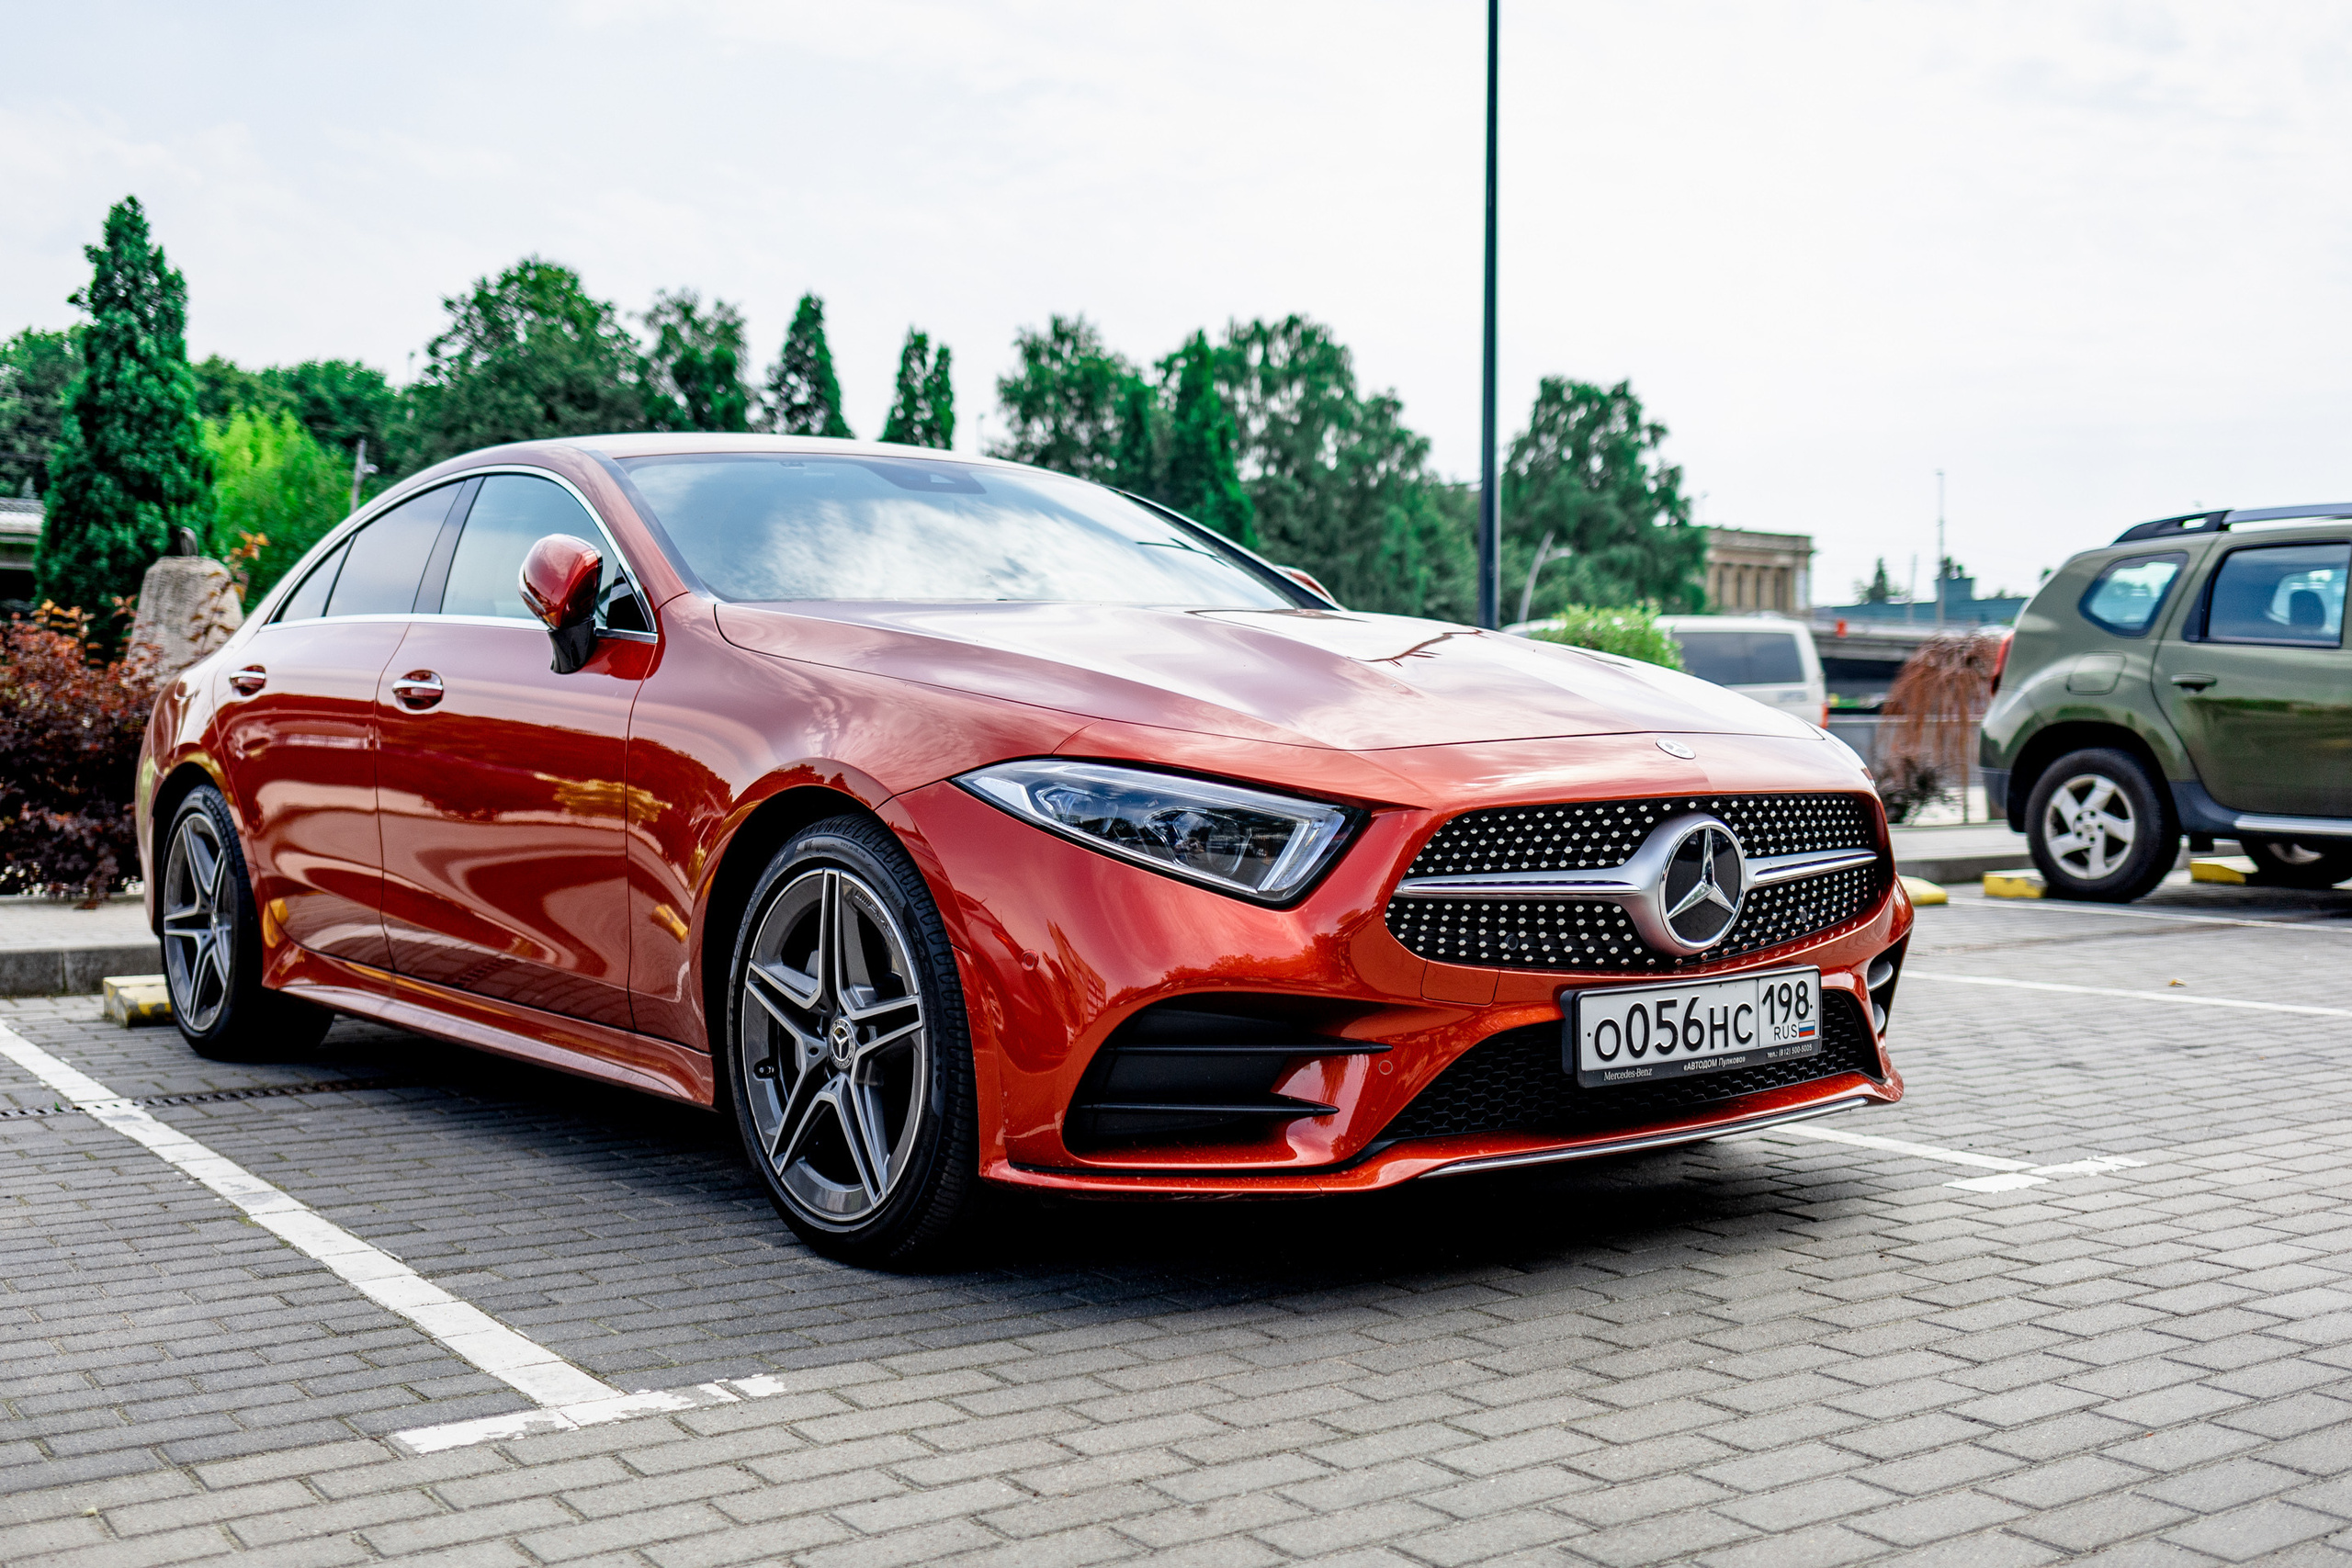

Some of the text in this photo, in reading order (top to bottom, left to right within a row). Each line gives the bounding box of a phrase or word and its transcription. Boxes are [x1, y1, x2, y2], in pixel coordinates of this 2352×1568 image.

[1762, 980, 1809, 1024] 198
[1774, 1024, 1798, 1041] RUS
[1779, 1047, 1791, 1057] (812)
[1792, 1043, 1813, 1055] 500-5005
[1603, 1068, 1653, 1081] Mercedes-Benz
